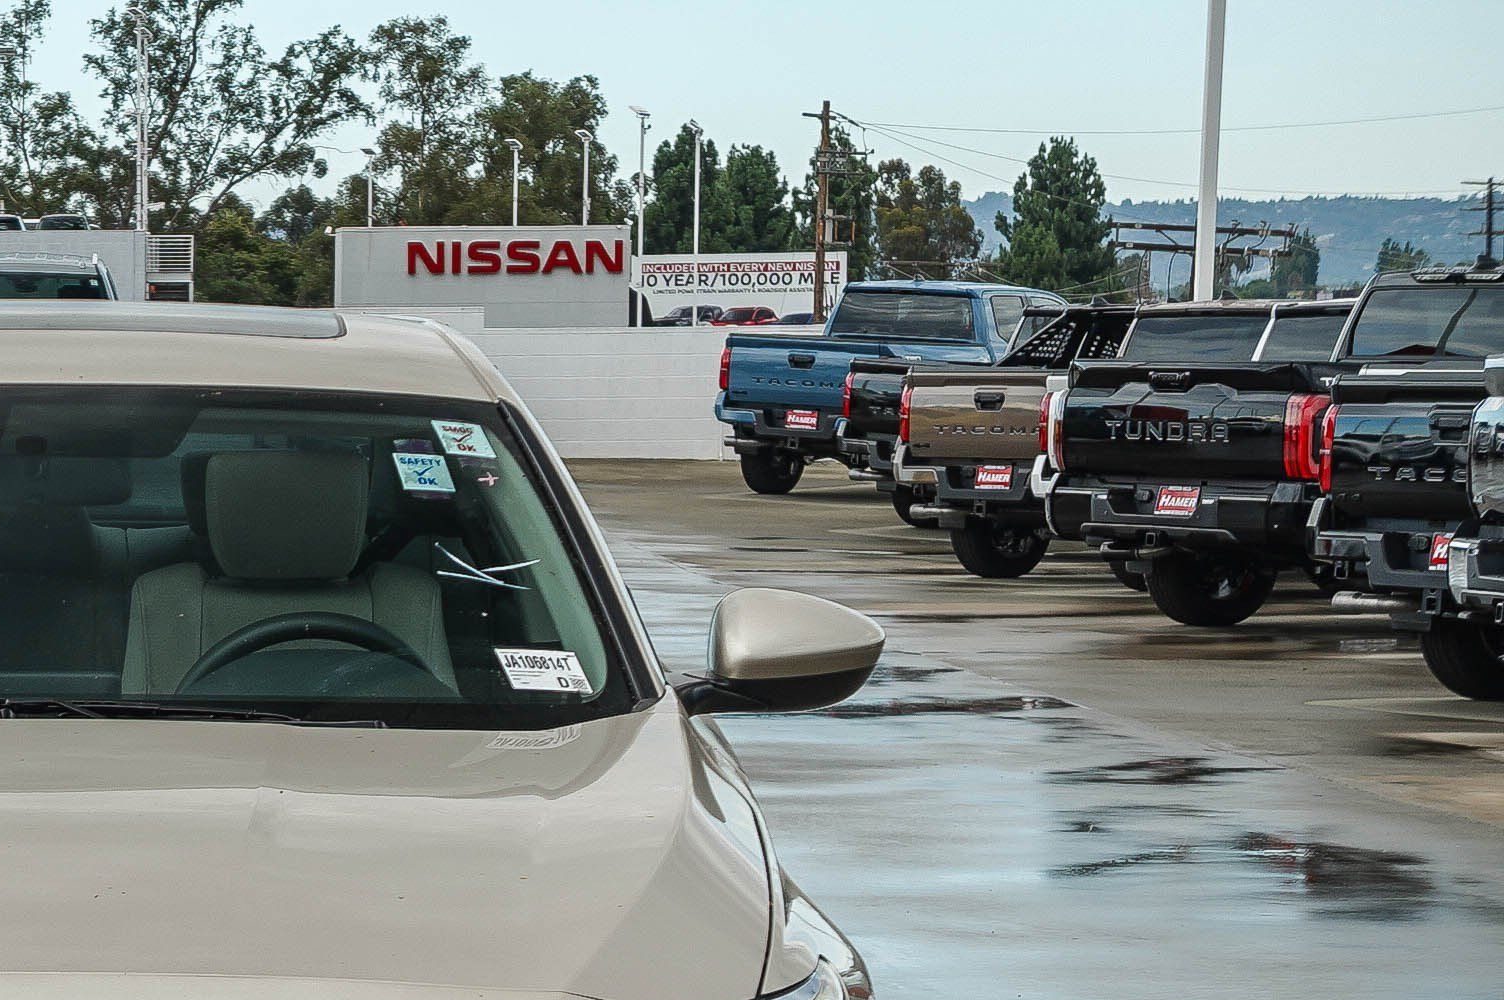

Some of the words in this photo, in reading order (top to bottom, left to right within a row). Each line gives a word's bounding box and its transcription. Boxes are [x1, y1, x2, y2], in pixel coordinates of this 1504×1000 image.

[407, 240, 624, 275] NISSAN
[642, 264, 695, 273] INCLUDED
[698, 263, 727, 272] WITH
[730, 262, 766, 272] EVERY
[767, 262, 794, 271] NEW
[795, 261, 837, 271] NISAN
[1104, 419, 1230, 443] TUNDRA
[399, 456, 442, 467] SAFETY
[977, 471, 1010, 483] HAMER
[1367, 466, 1467, 483] TACO
[1158, 494, 1198, 508] HAMER
